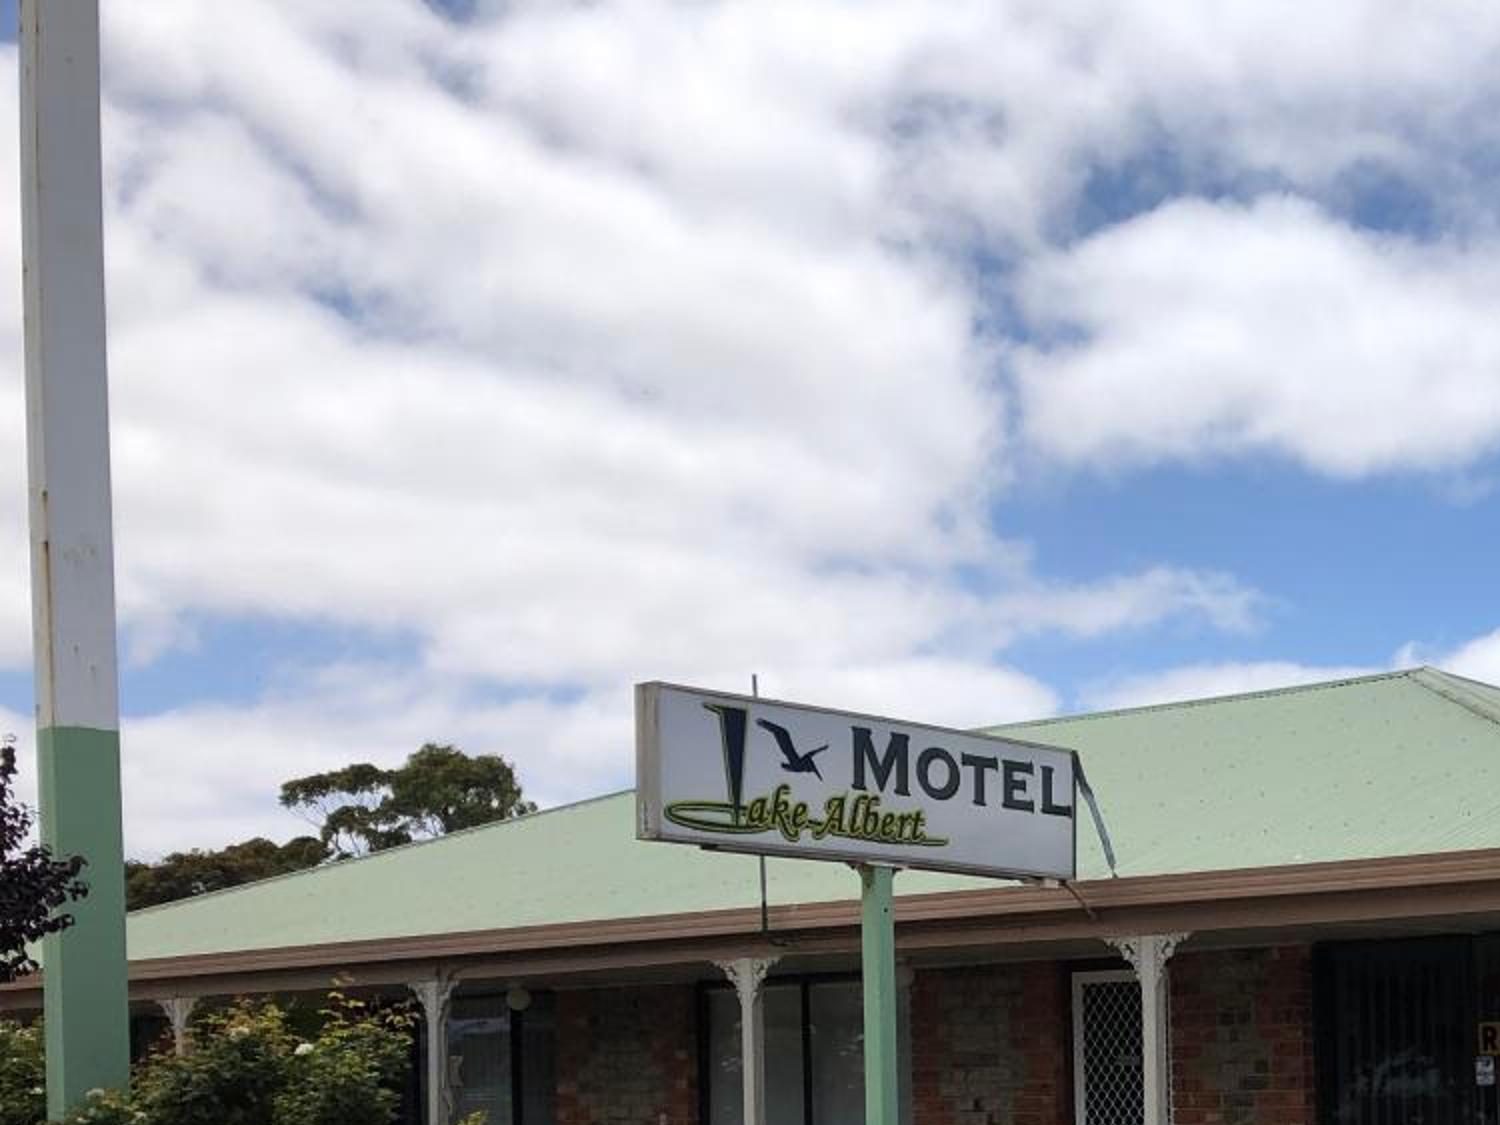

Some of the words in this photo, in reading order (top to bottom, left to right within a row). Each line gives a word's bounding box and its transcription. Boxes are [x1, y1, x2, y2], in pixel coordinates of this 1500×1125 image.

[664, 704, 808, 842] Lake
[811, 790, 948, 846] Albert
[850, 725, 1072, 817] MOTEL
